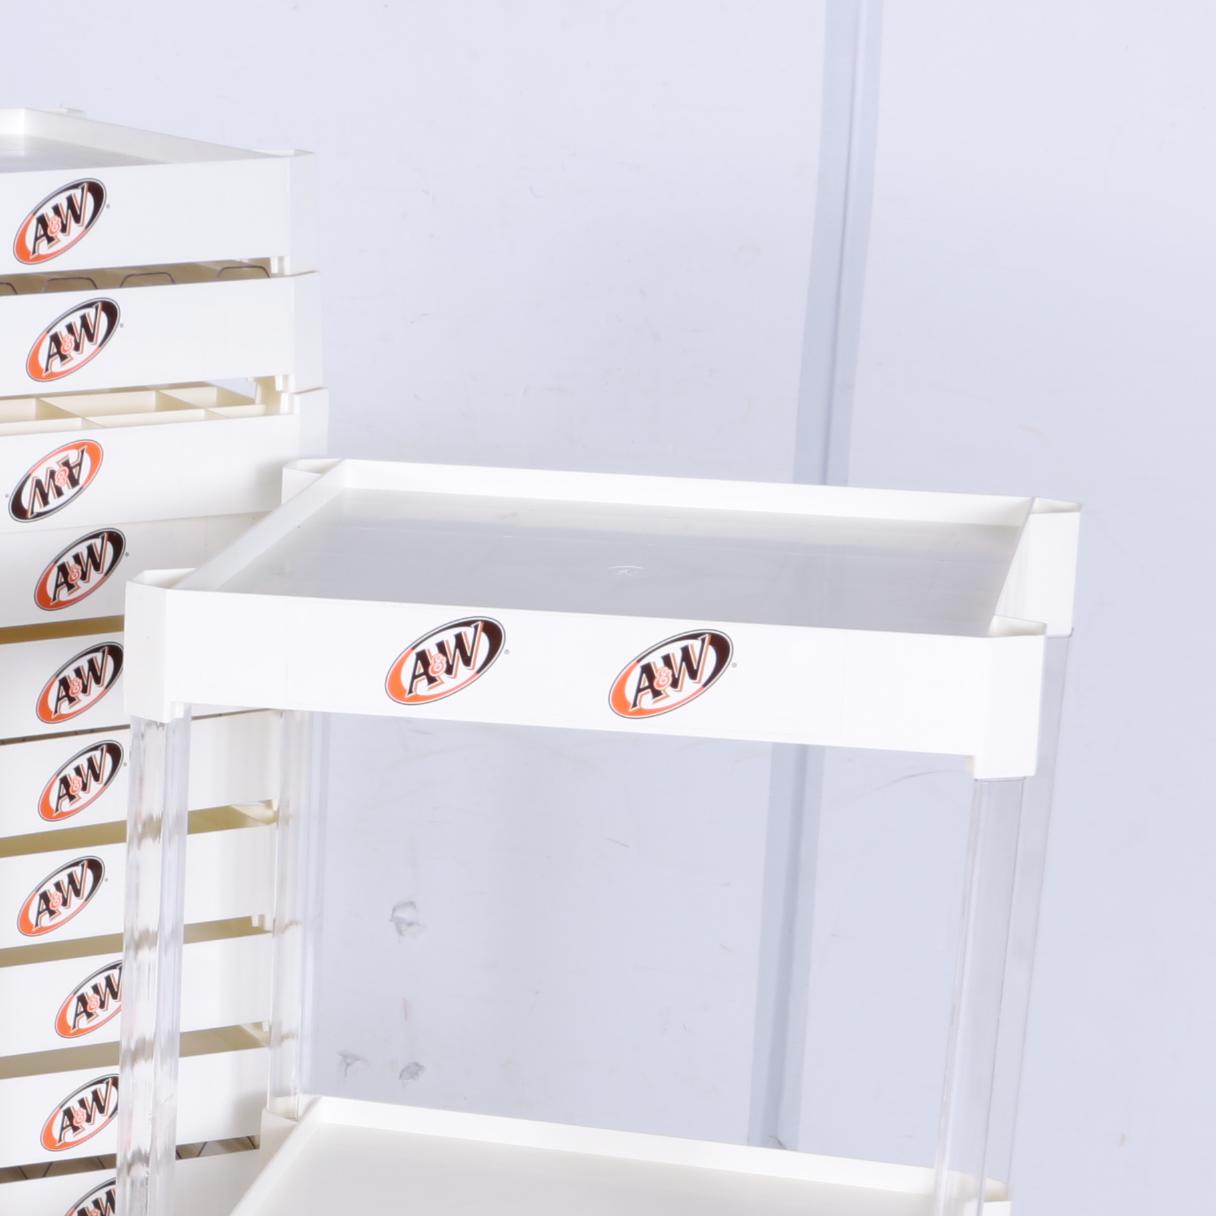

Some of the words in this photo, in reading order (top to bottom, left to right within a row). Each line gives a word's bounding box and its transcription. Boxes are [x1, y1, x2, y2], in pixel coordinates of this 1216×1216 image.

[30, 182, 88, 258] A&W
[43, 301, 103, 376] A&W
[26, 445, 86, 519] A&W
[51, 531, 109, 605] A&W
[52, 645, 109, 718] A&W
[406, 620, 484, 698] A&W
[629, 633, 711, 711] A&W
[53, 743, 107, 816] A&W
[33, 859, 88, 931] A&W
[56, 1077, 113, 1146] A&W
